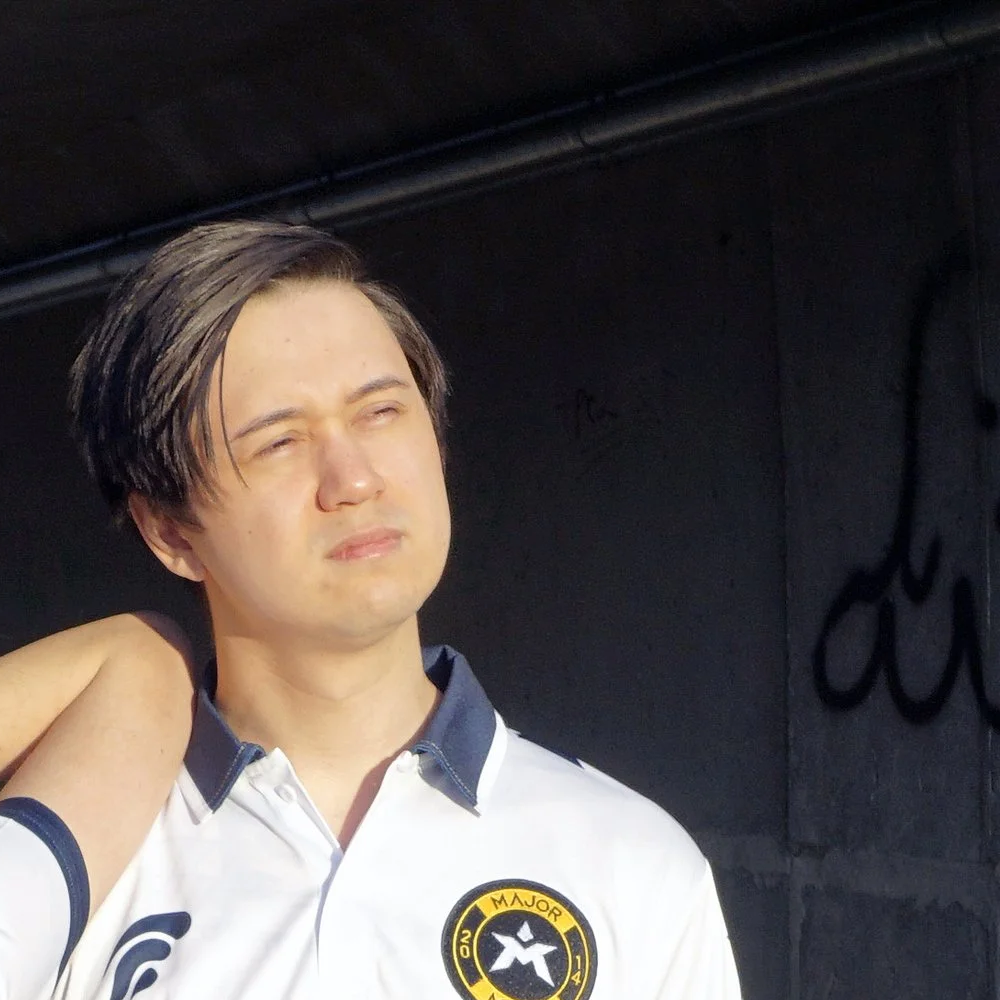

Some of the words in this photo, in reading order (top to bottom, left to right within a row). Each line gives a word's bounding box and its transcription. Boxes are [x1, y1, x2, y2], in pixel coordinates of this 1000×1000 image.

[490, 892, 562, 922] MAJOR
[459, 929, 472, 959] 20
[571, 955, 582, 986] 14
